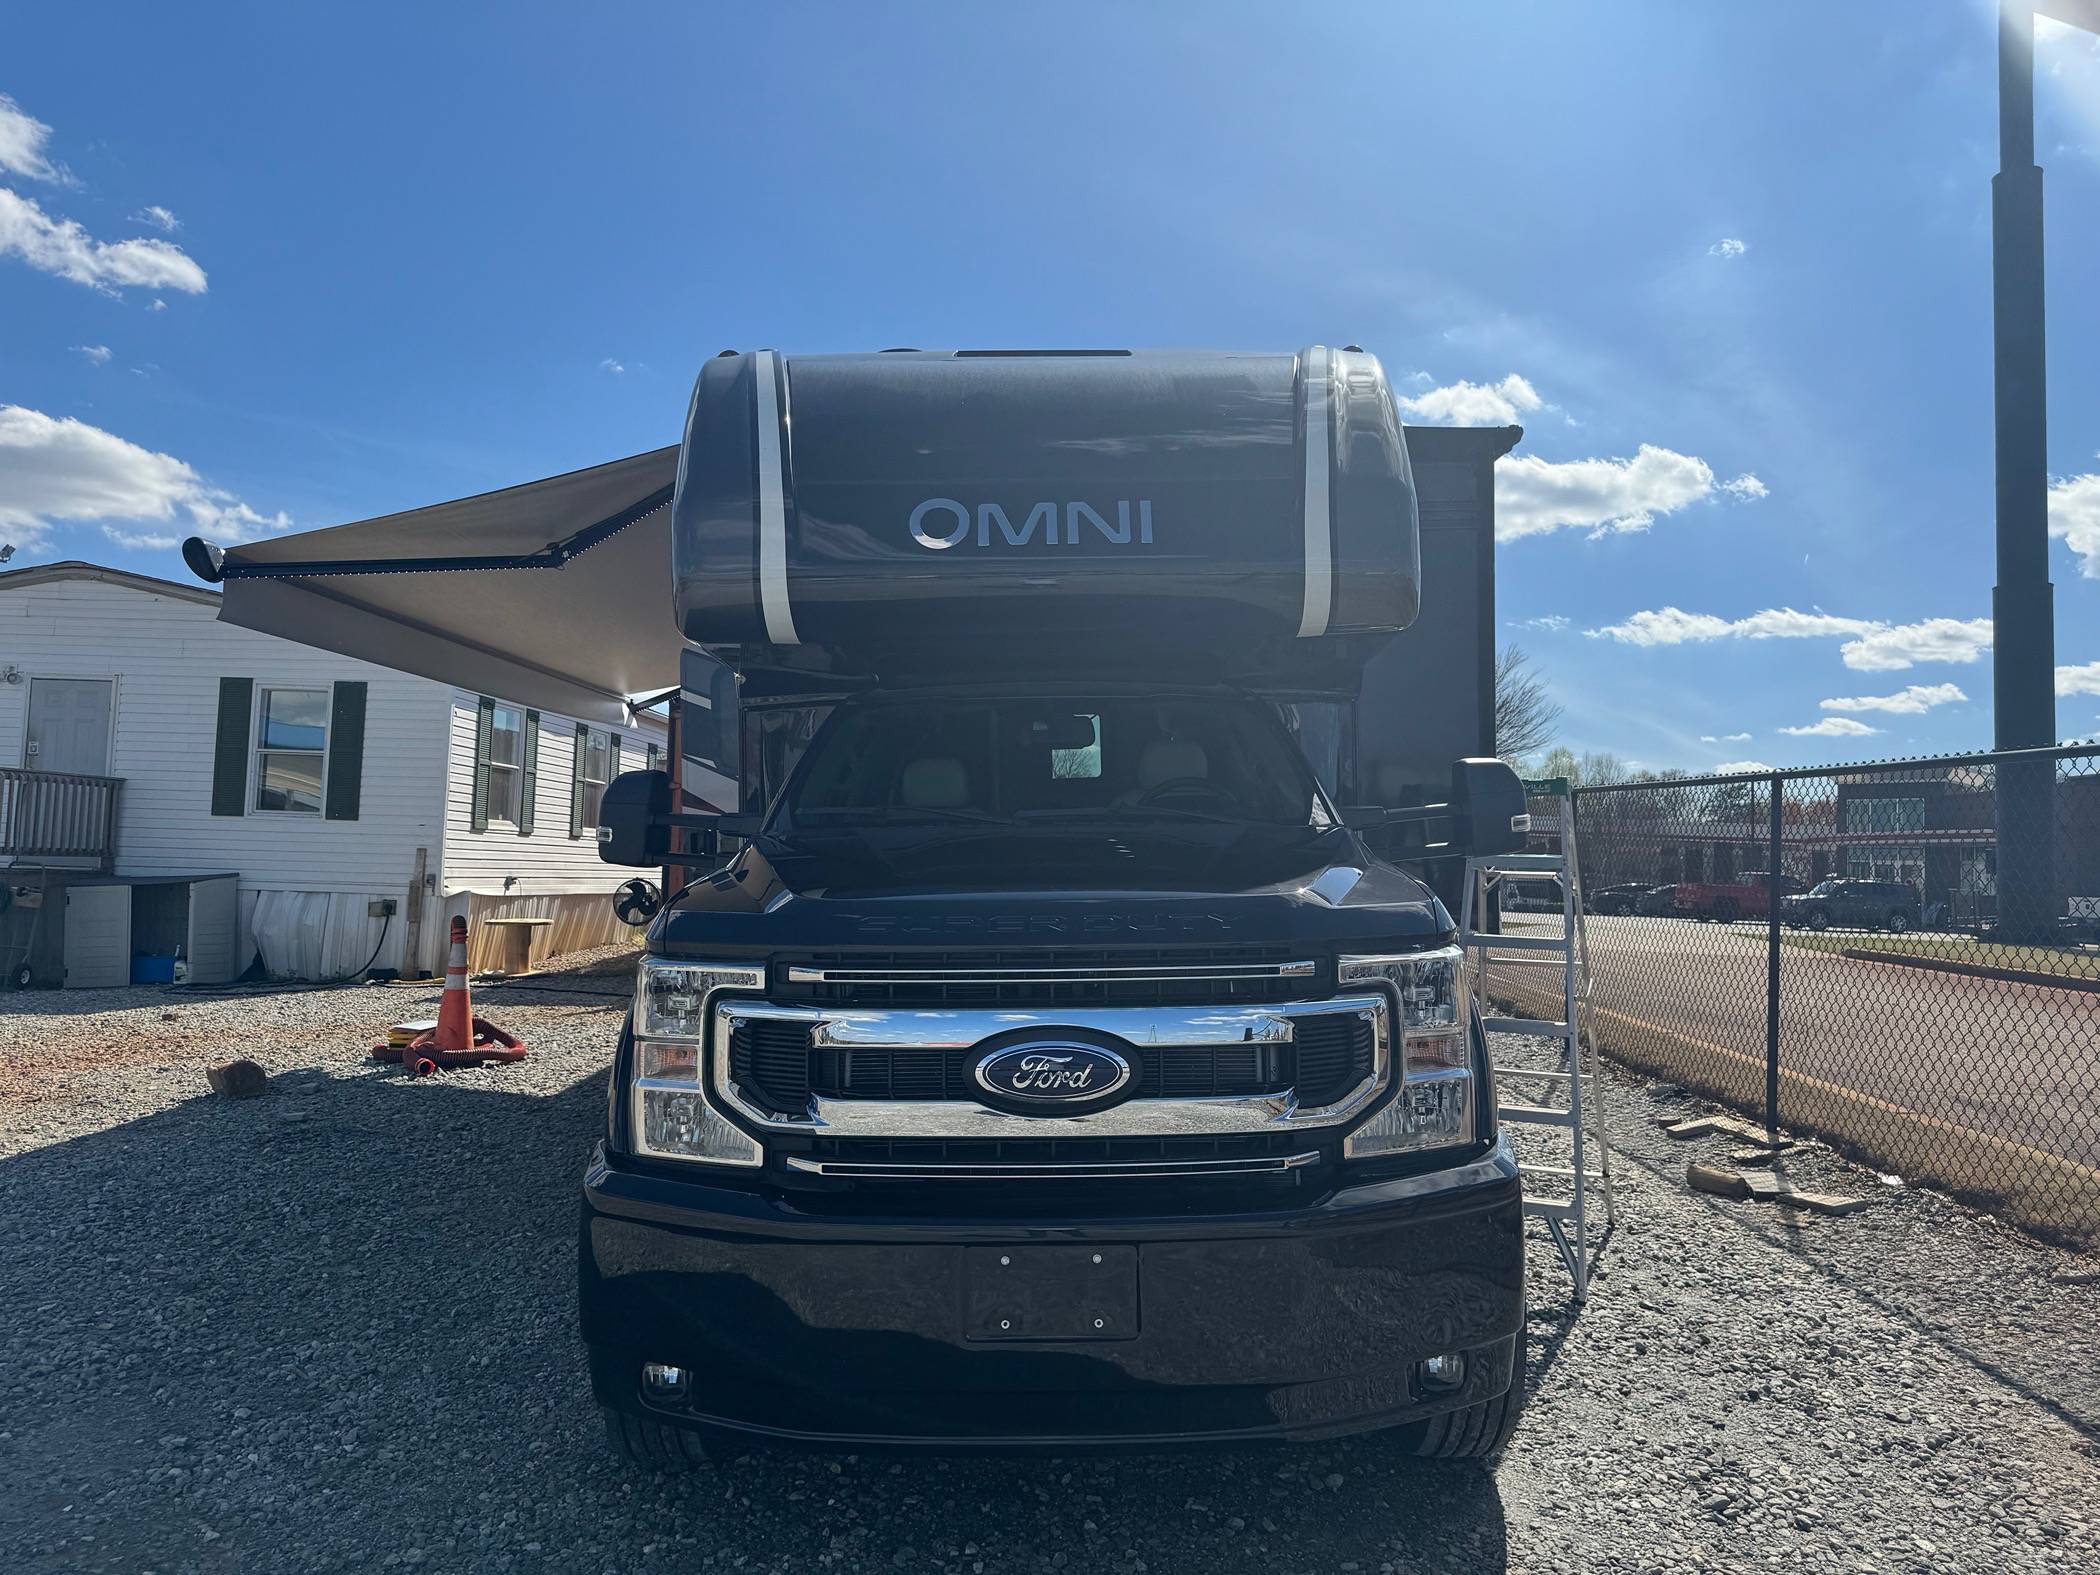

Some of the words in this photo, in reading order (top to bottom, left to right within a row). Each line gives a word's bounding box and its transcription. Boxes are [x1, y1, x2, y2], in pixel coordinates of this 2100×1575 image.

[909, 498, 1153, 549] OMNI
[857, 914, 1067, 936] SUPER
[1082, 912, 1246, 934] DUTY
[1012, 1055, 1094, 1089] Ford
